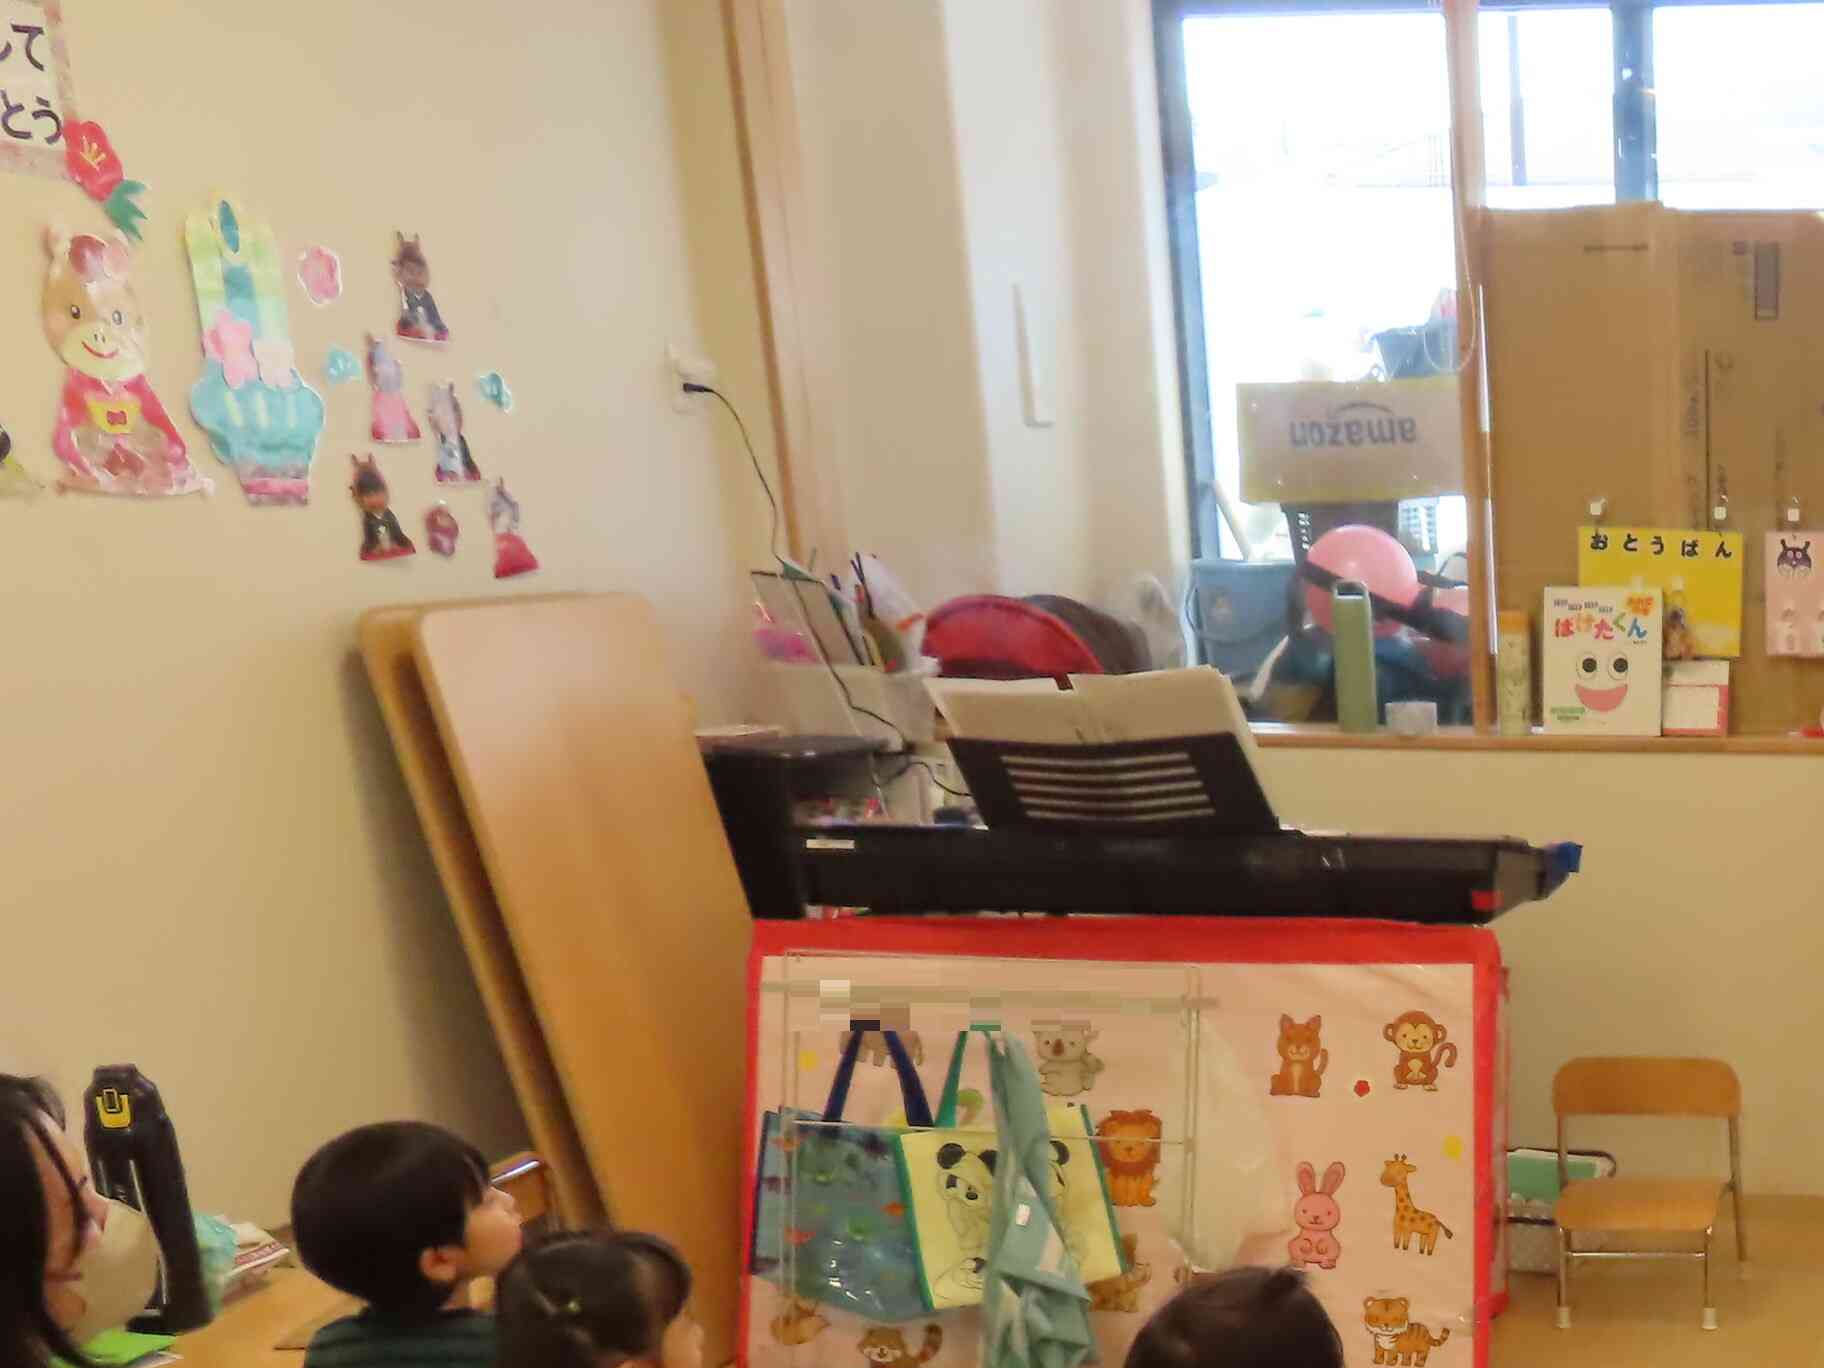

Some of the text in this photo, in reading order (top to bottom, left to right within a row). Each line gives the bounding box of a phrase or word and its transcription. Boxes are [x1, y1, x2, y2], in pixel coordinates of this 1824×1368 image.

[1289, 416, 1417, 447] amazon
[1590, 533, 1732, 558] おとうばん
